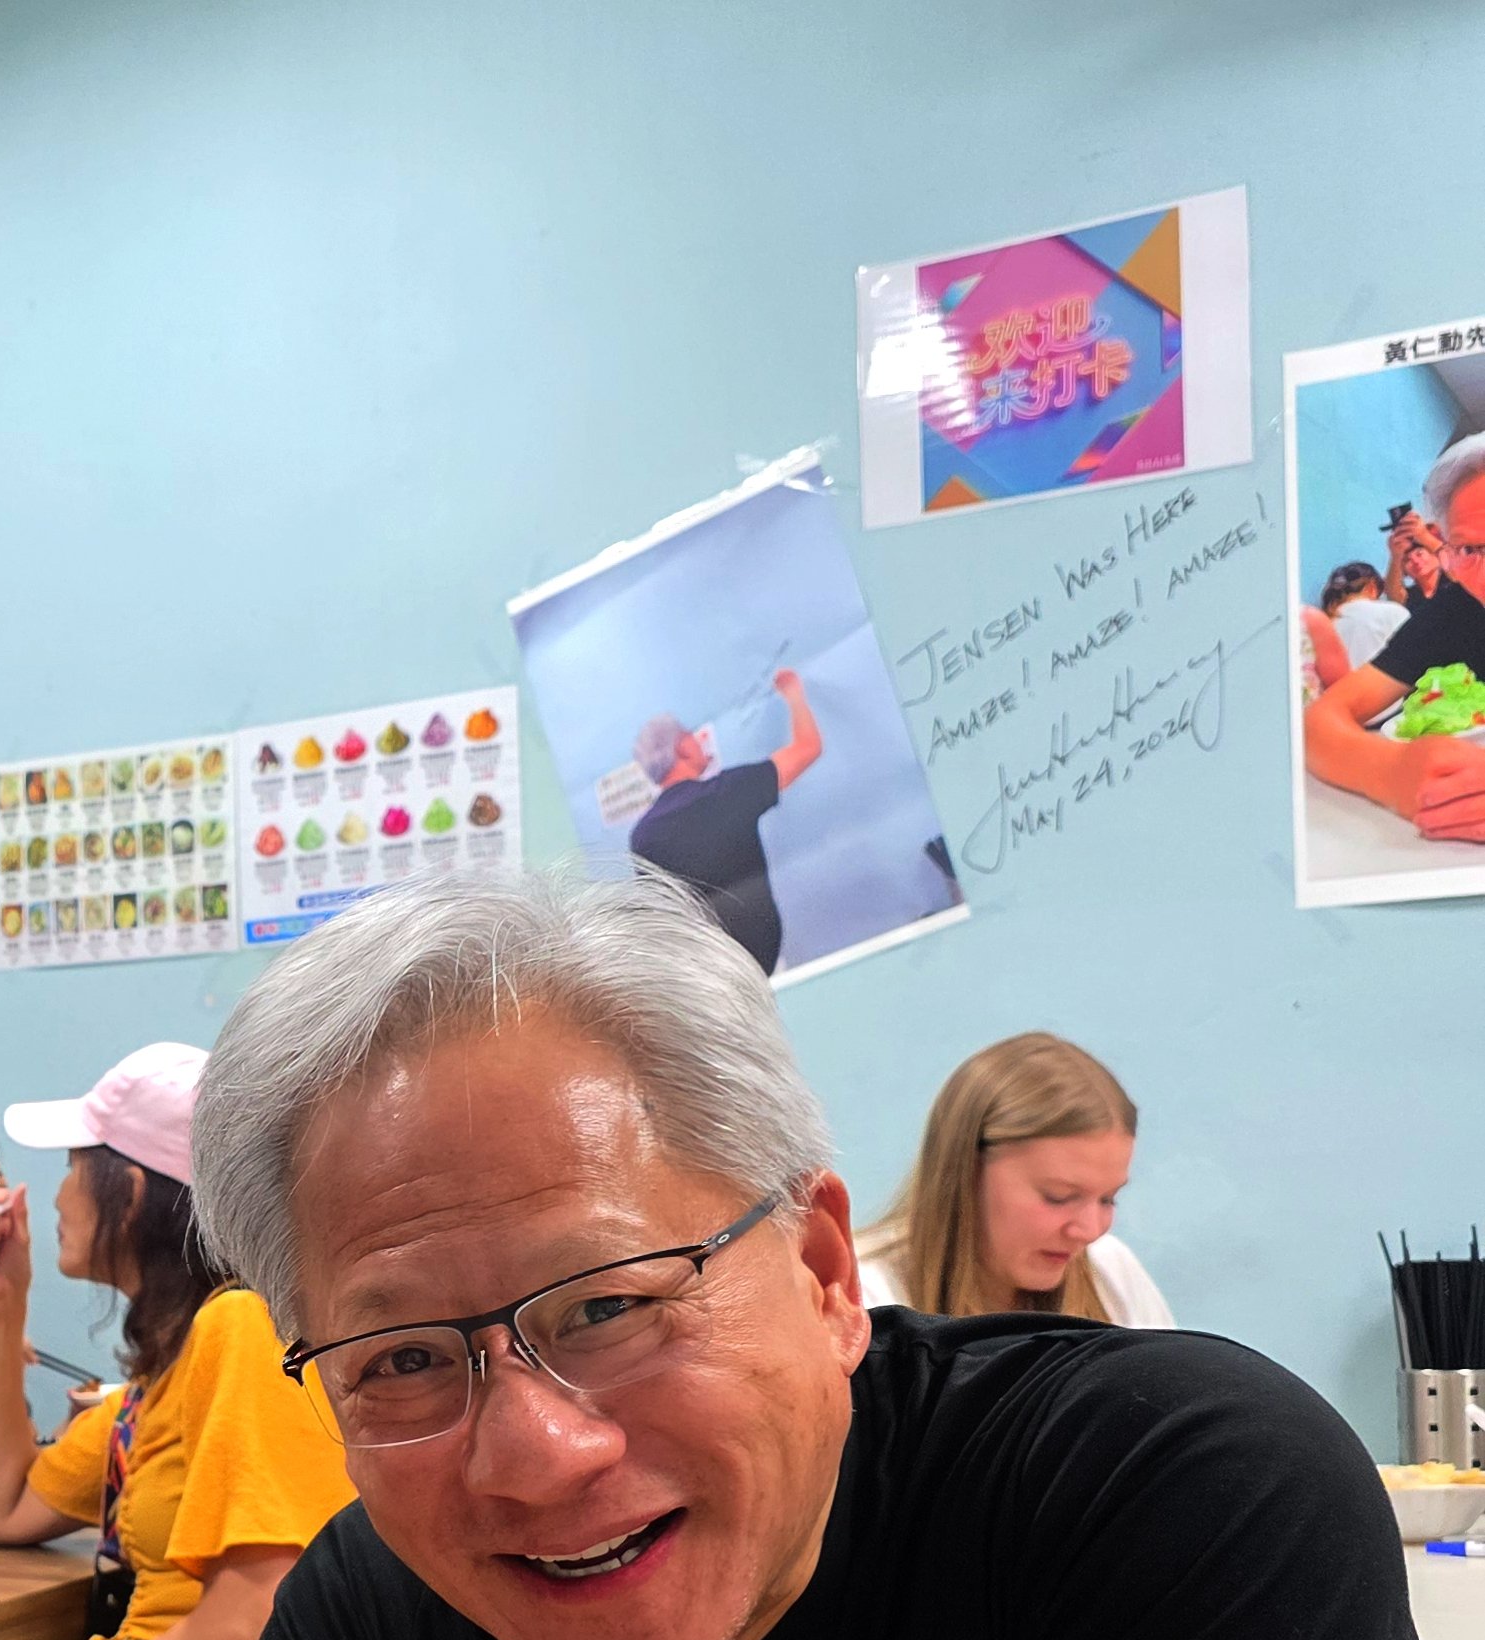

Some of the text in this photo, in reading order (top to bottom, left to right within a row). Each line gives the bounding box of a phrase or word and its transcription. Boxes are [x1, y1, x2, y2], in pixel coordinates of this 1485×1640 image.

[966, 296, 1110, 374] 欢迎
[961, 343, 1132, 438] 来打卡
[897, 597, 1042, 709] JENSEN
[1124, 485, 1198, 556] HERE
[927, 491, 1277, 767] AMAZE! AMAZE! AMAZE!
[1127, 697, 1192, 761] 2026
